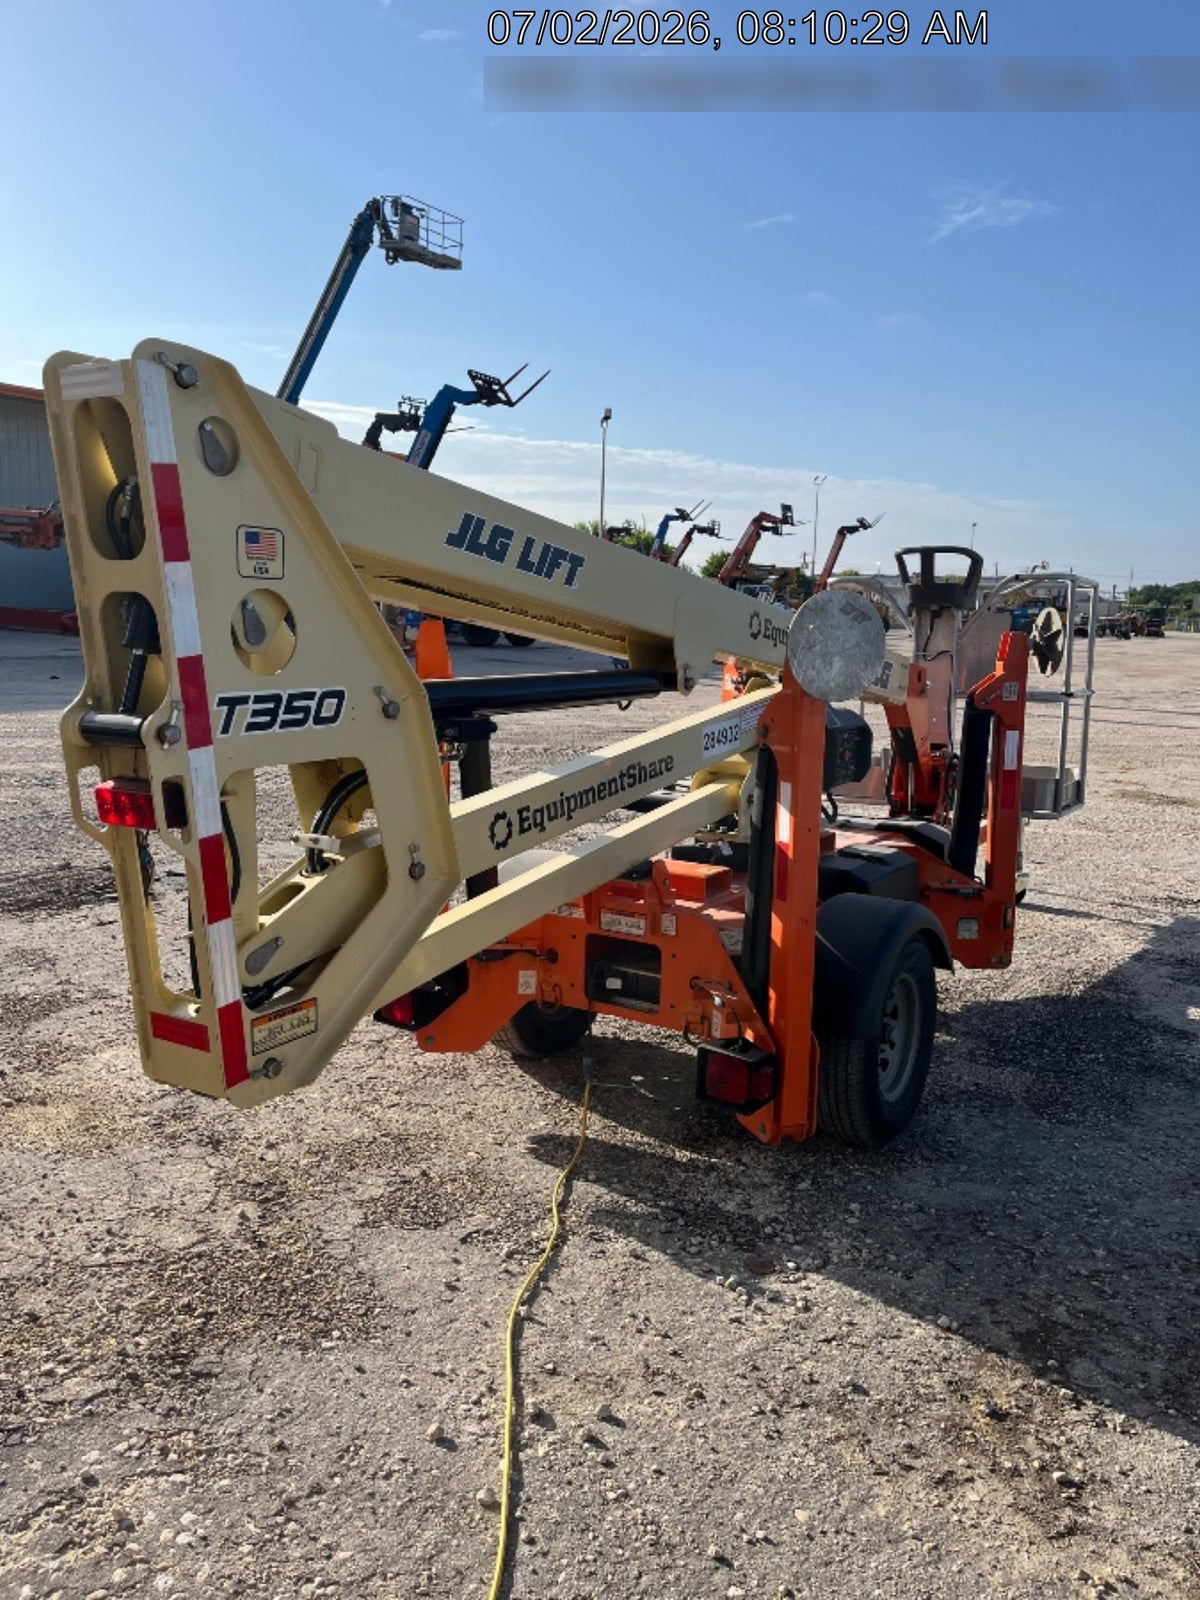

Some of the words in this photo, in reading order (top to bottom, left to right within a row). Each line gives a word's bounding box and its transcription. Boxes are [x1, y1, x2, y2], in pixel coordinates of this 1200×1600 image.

[444, 511, 516, 565] JLG
[515, 535, 587, 588] LIFT
[215, 687, 346, 737] T350
[517, 754, 675, 836] EquipmentShare
